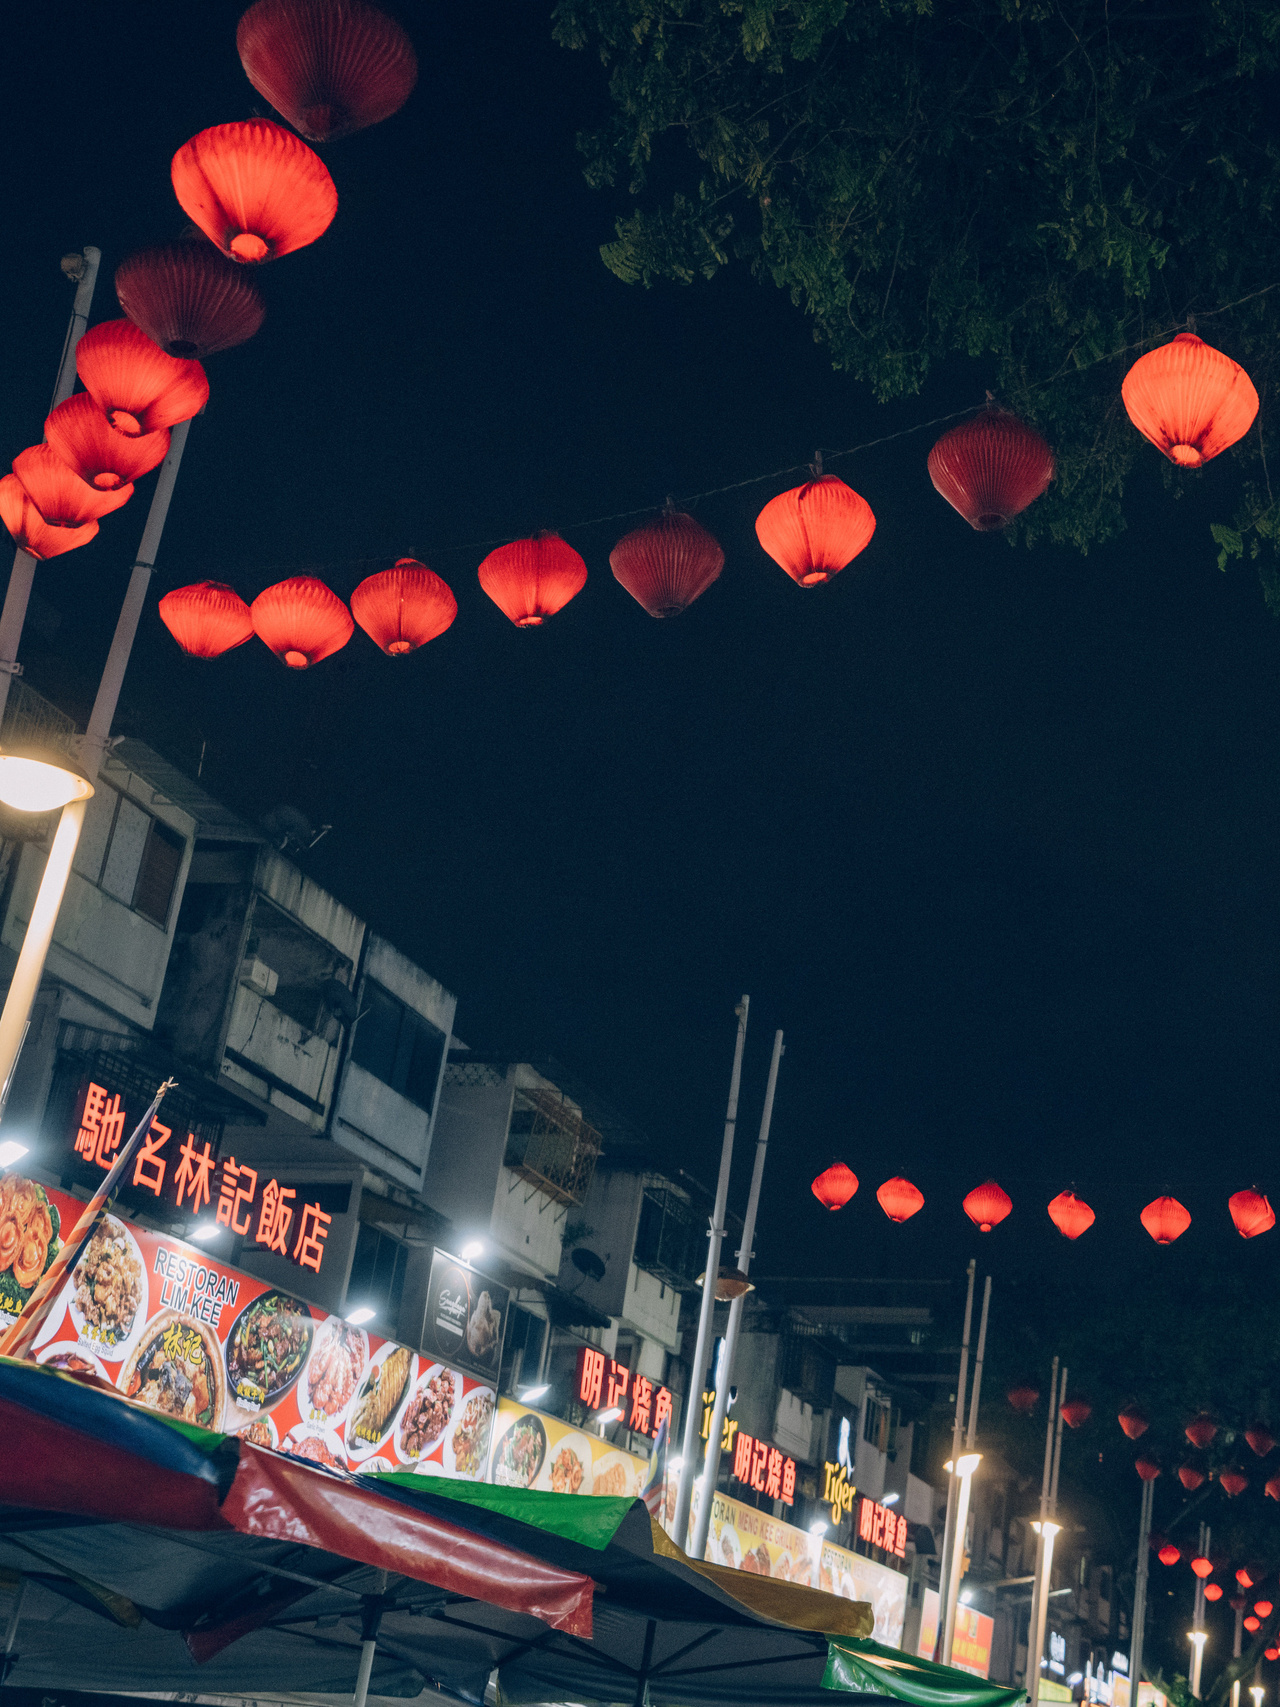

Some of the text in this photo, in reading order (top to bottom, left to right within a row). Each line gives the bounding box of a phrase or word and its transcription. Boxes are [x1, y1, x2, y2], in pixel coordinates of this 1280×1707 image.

[74, 1082, 331, 1273] 馳名林記飯店
[154, 1247, 239, 1306] RESTORAN
[160, 1280, 223, 1326] LIM KEE
[163, 1321, 203, 1365] 林记
[580, 1347, 673, 1444] 明记烧鱼
[733, 1431, 797, 1506] 明记烧鱼
[824, 1461, 857, 1526] Tiger
[737, 1510, 759, 1537] MENG
[759, 1519, 775, 1542] KEE
[859, 1497, 908, 1559] 明记烧鱼
